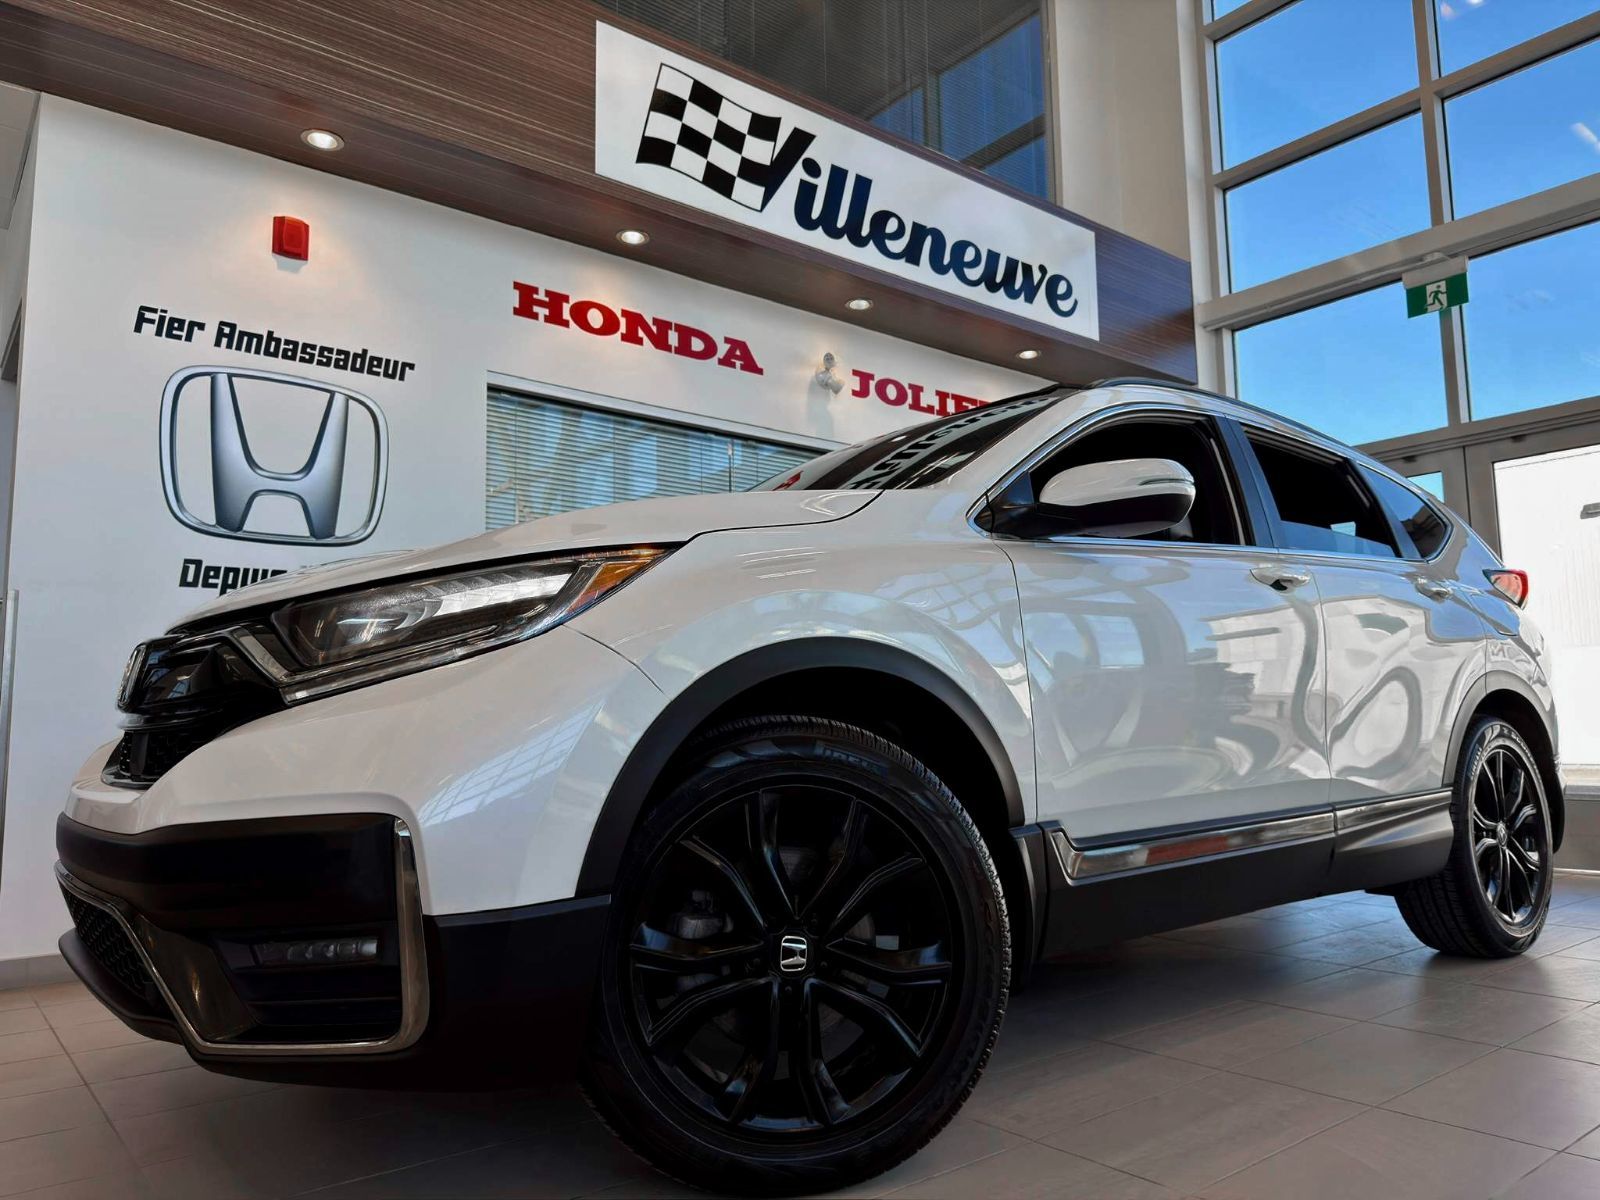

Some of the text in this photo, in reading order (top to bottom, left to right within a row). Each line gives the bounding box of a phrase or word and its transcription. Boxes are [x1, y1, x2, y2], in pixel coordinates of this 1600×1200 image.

[757, 126, 1078, 318] Villeneuve
[133, 305, 416, 382] Fier Ambassadeur
[512, 281, 764, 376] HONDA
[851, 368, 992, 417] JOLIE
